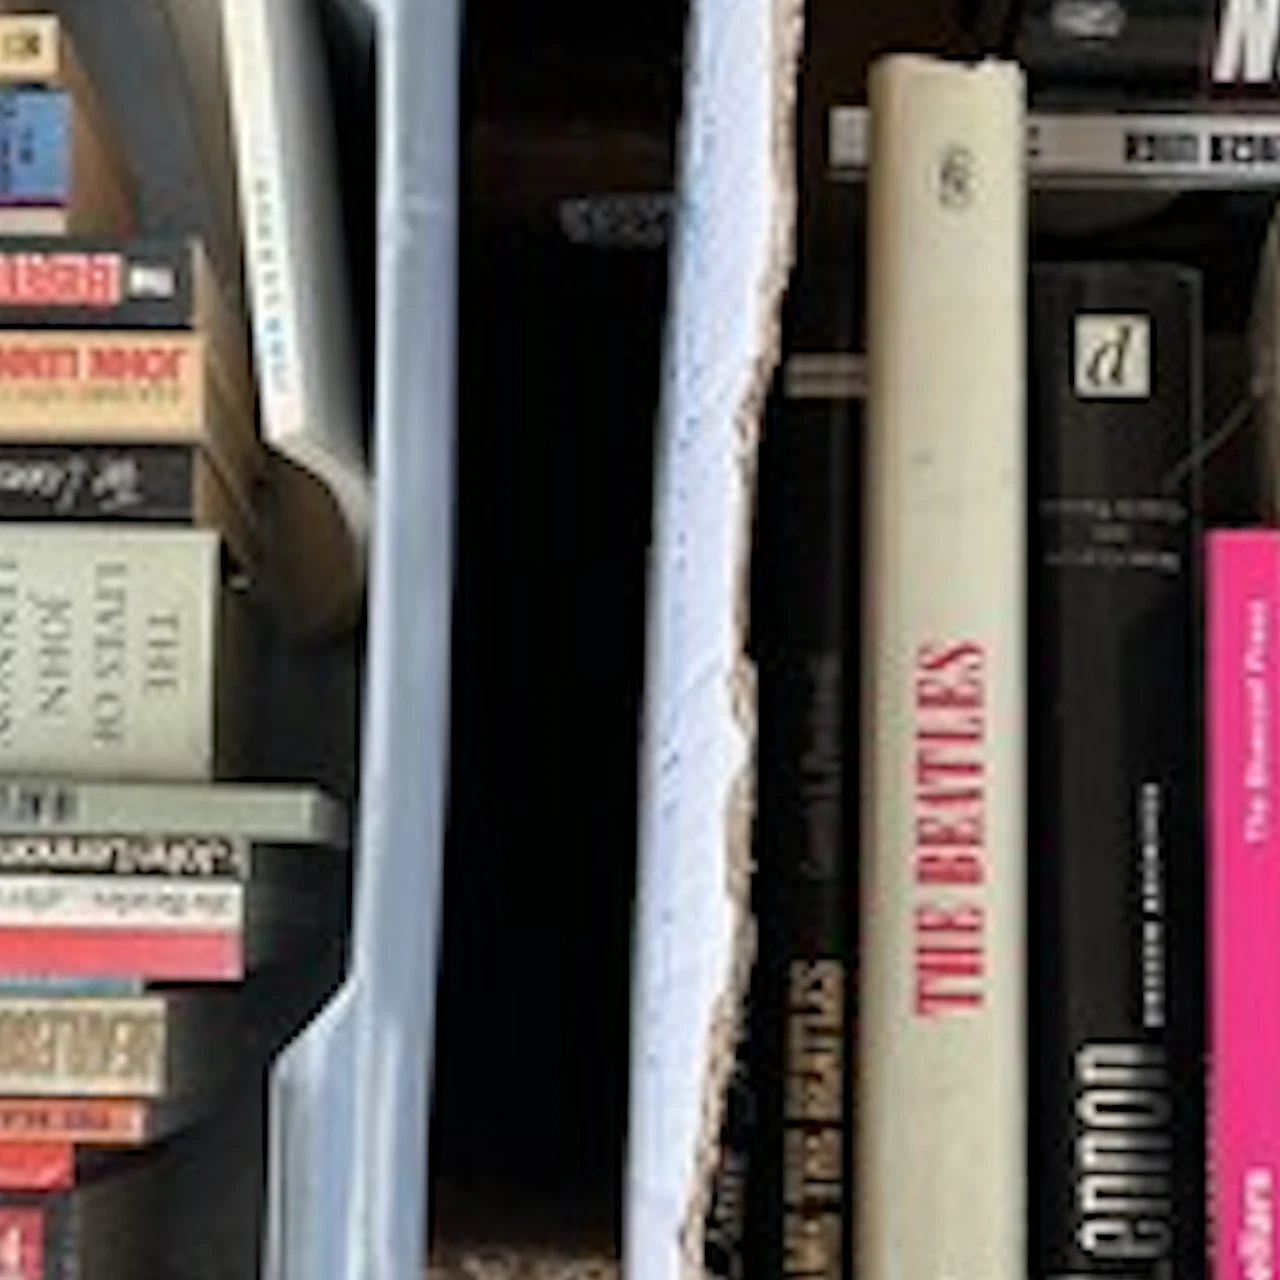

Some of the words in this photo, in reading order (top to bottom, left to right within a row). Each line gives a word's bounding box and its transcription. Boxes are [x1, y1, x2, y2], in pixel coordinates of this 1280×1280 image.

[88, 349, 184, 383] JOHN
[26, 593, 73, 716] JOHN
[93, 562, 129, 679] LIVES
[143, 613, 181, 693] THE
[1241, 599, 1268, 672] Press
[93, 692, 125, 745] OF
[911, 643, 985, 886] BEATLES
[1243, 793, 1269, 844] The
[915, 905, 987, 1019] THE
[785, 958, 843, 1122] BEATLES
